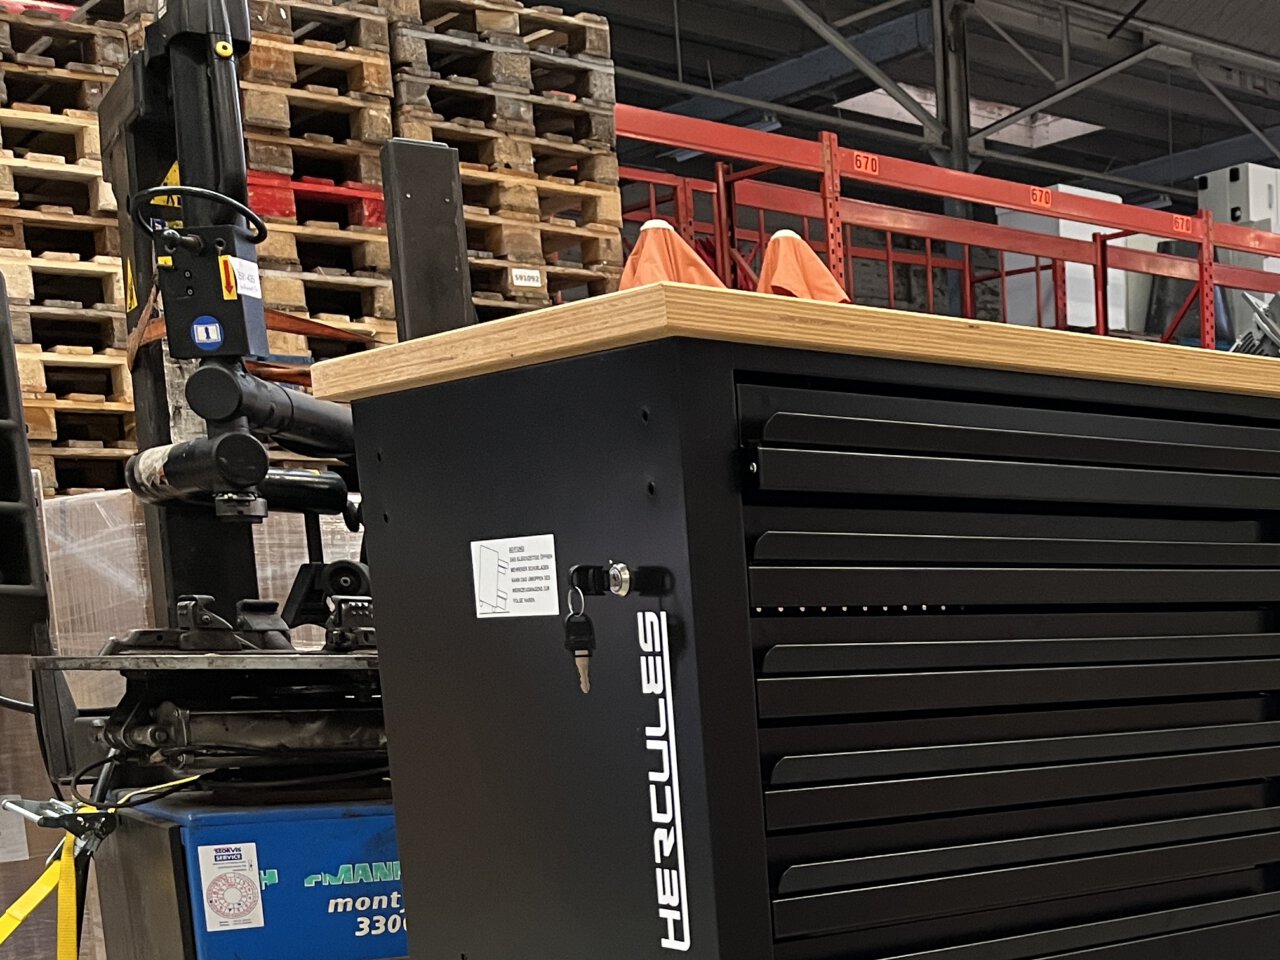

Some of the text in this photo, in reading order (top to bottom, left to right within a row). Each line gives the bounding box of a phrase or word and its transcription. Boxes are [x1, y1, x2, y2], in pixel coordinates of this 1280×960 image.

[855, 154, 877, 173] 670
[1031, 188, 1051, 204] 670
[1174, 217, 1192, 232] 670
[637, 610, 690, 951] HERCULES
[328, 891, 406, 913] mont
[355, 914, 408, 937] 330
